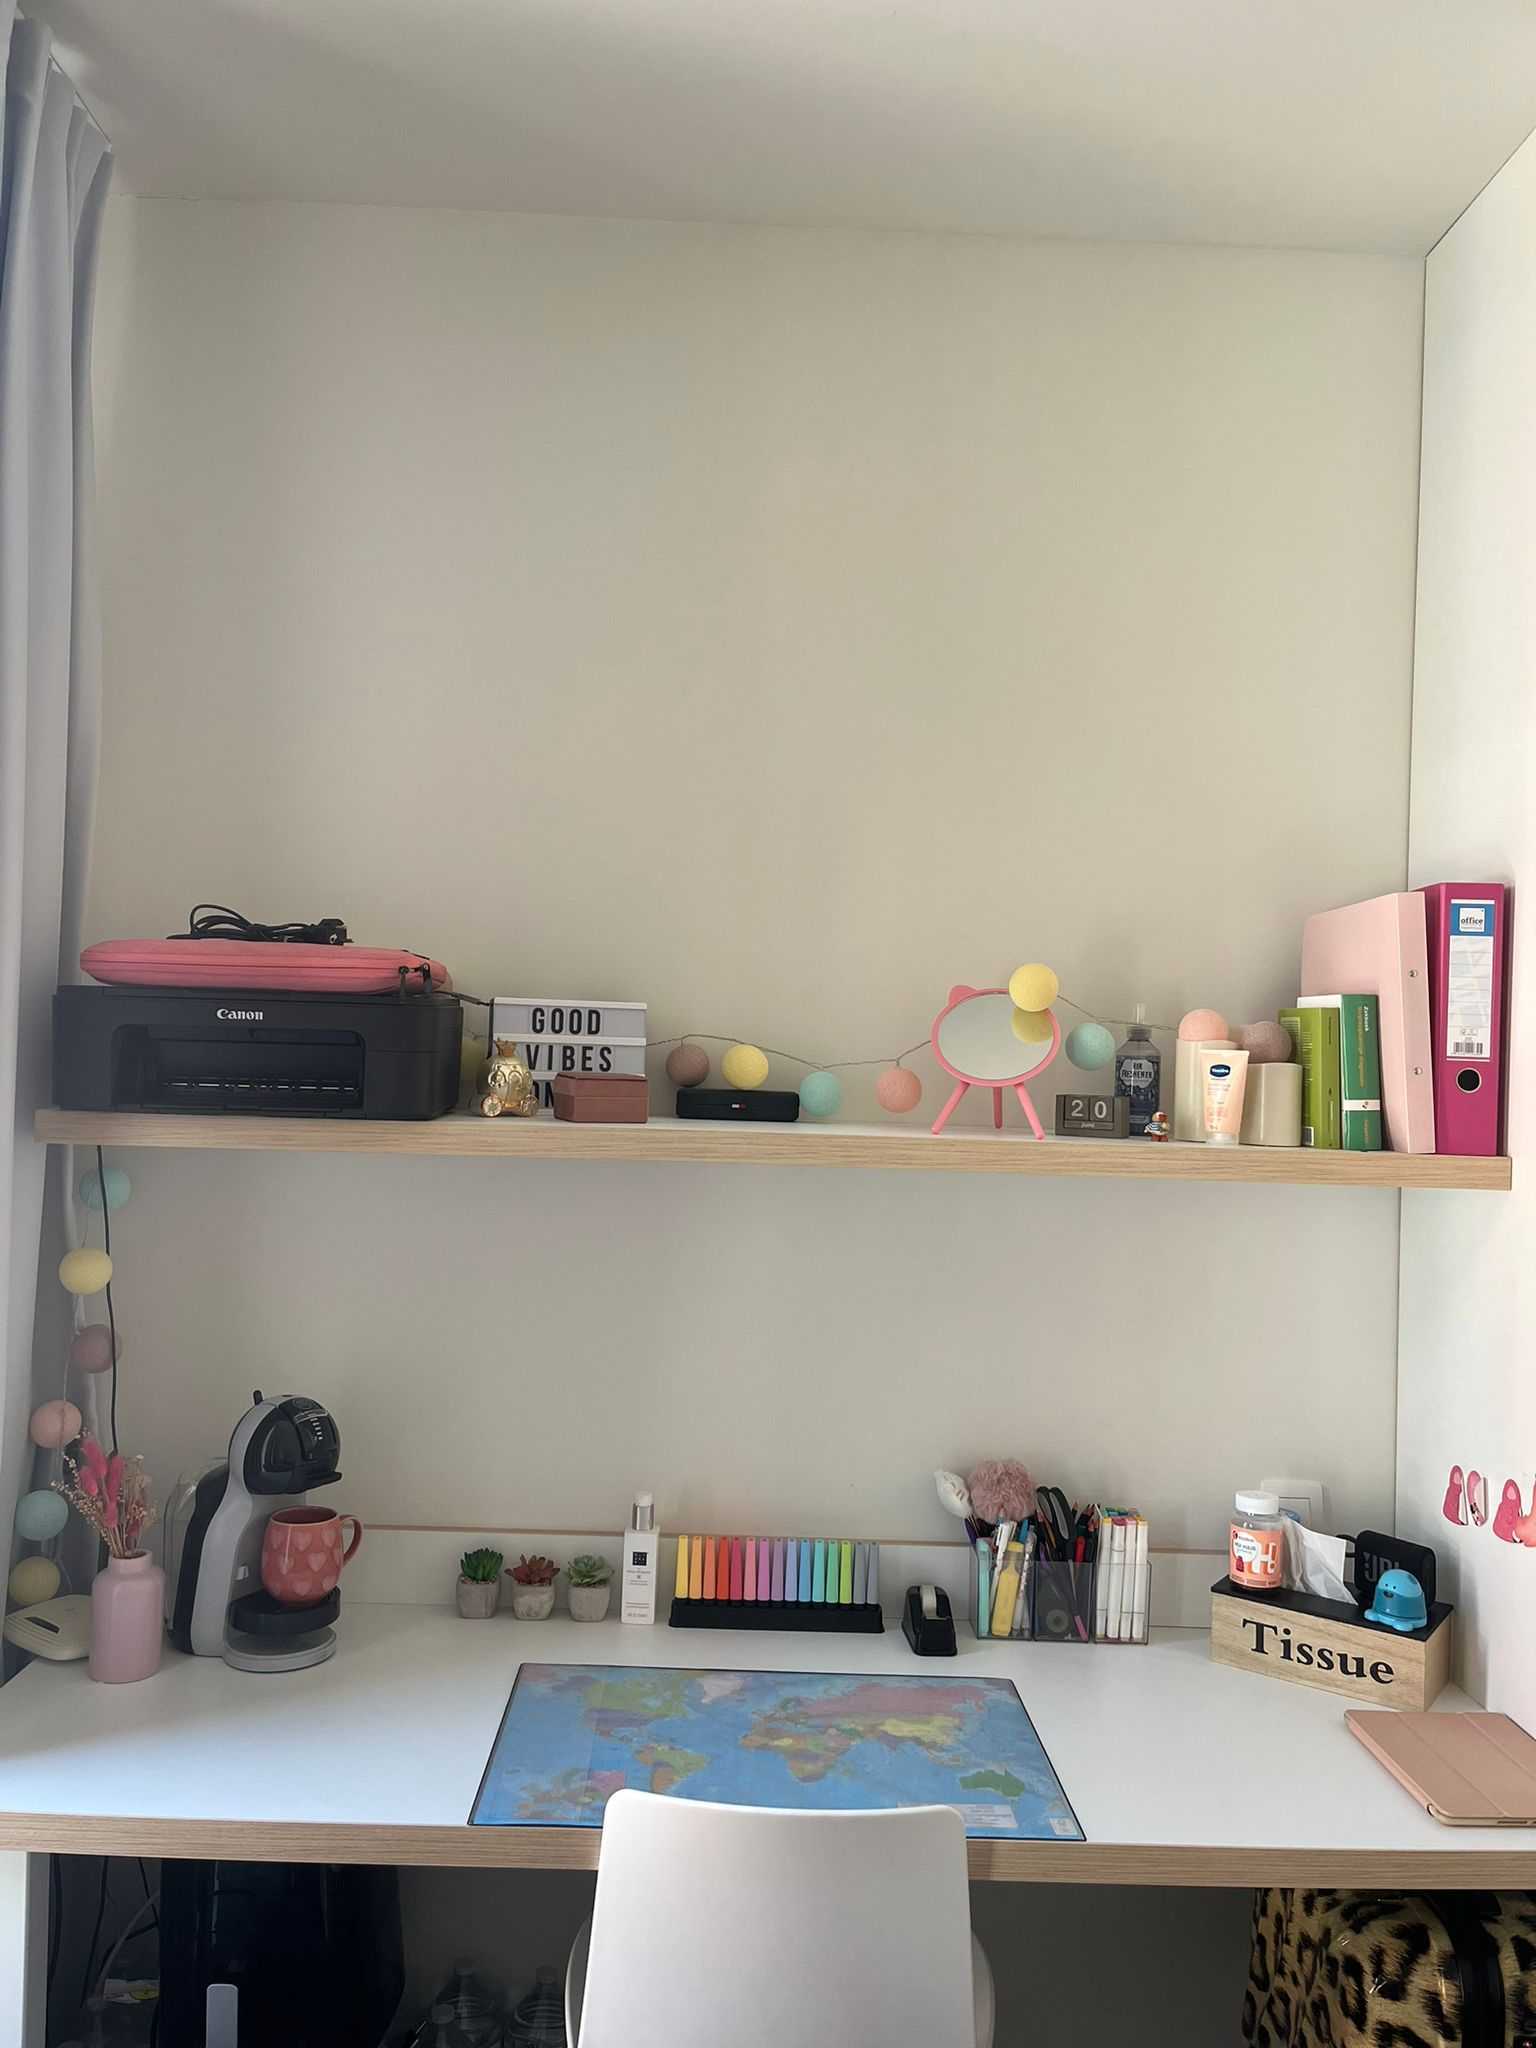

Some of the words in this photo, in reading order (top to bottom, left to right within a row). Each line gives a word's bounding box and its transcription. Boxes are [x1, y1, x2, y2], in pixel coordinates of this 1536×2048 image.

[1460, 916, 1483, 925] office
[216, 1008, 264, 1020] Canon
[532, 1007, 601, 1035] GOOD
[526, 1044, 612, 1072] VIBES
[1242, 1618, 1395, 1685] Tissue
